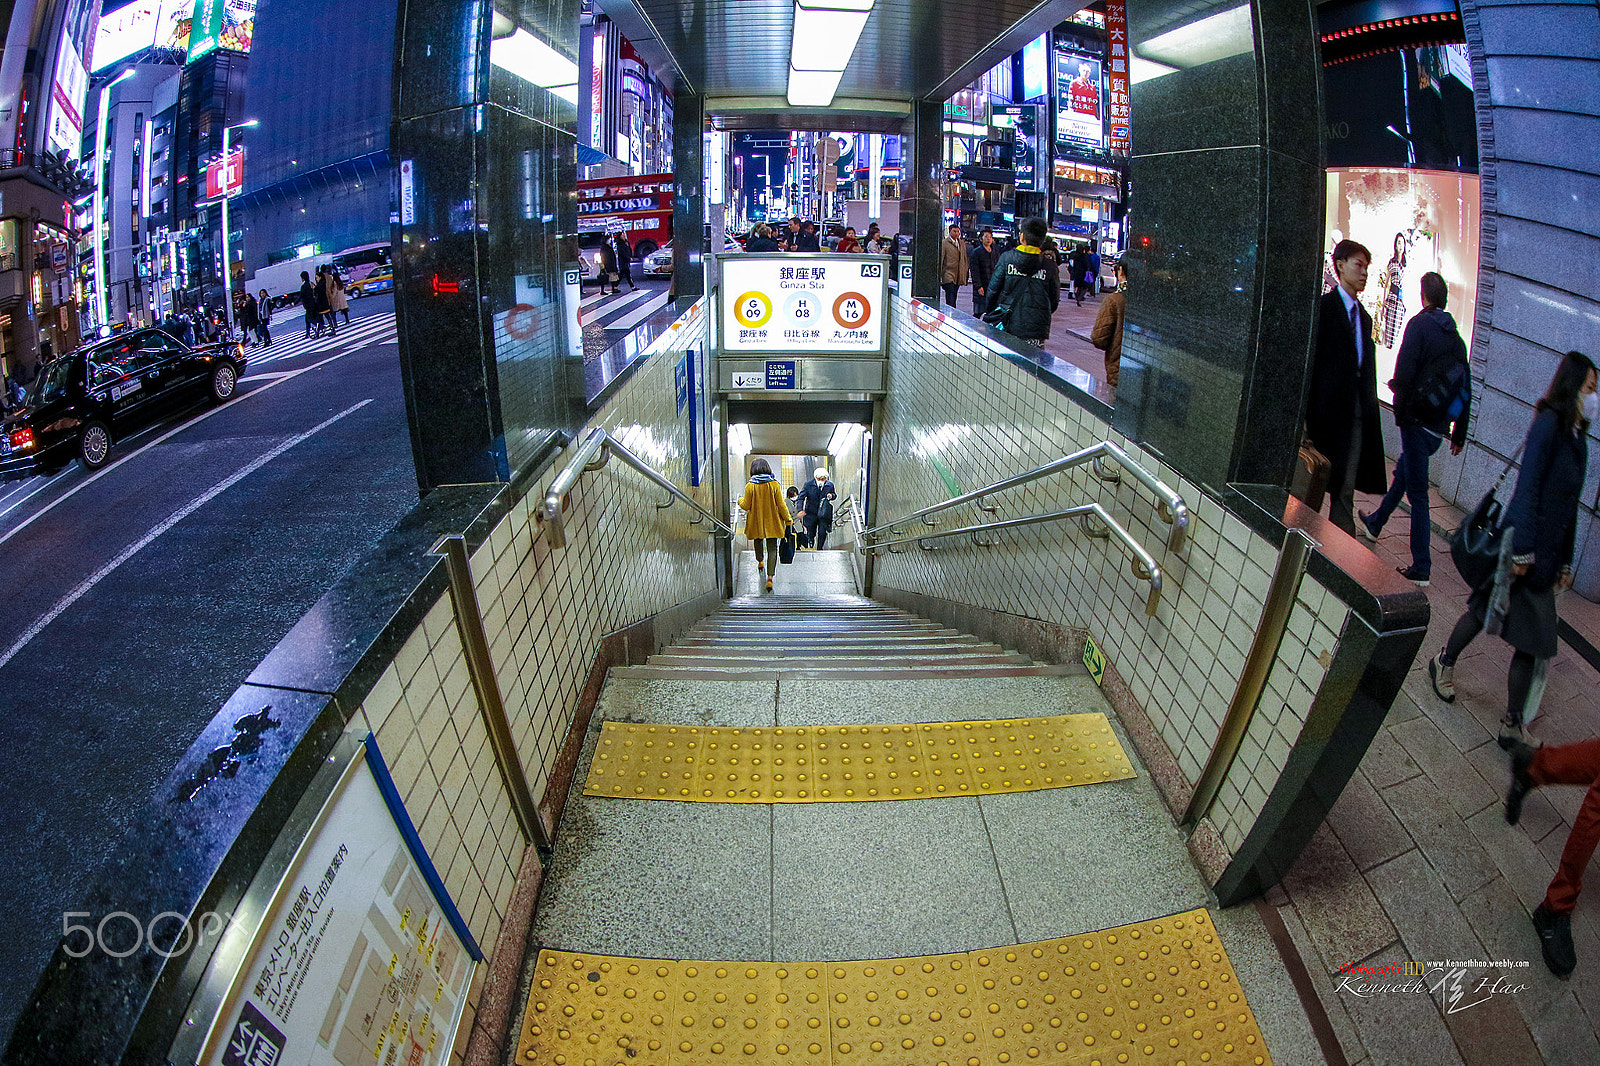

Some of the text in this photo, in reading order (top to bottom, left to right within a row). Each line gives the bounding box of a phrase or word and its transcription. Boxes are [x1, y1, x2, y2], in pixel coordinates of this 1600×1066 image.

[1112, 78, 1126, 92] 質
[1111, 92, 1128, 105] 買取
[1111, 105, 1129, 117] 販売
[592, 201, 612, 211] BUS
[613, 198, 652, 210] TOKYO
[780, 267, 826, 280] 銀座駅
[863, 265, 881, 277] A9
[780, 281, 806, 289] Ginza
[749, 300, 758, 308] G
[798, 300, 807, 308] H
[846, 300, 857, 308] M
[746, 309, 761, 318] 09
[795, 309, 810, 318] 08
[845, 310, 859, 319] 16
[739, 330, 768, 338] 銀座線
[784, 330, 820, 338] 日比谷線
[833, 330, 869, 339] 丸ノ内線
[266, 843, 348, 1012] エレベーター出入口位置案内
[254, 885, 311, 1001] 東京メトロ 銀座駅
[281, 907, 335, 1024] Entrance equipped with Elevator
[276, 995, 289, 1018] Tokyo
[286, 970, 299, 994] Metro
[297, 948, 309, 970] Ginza
